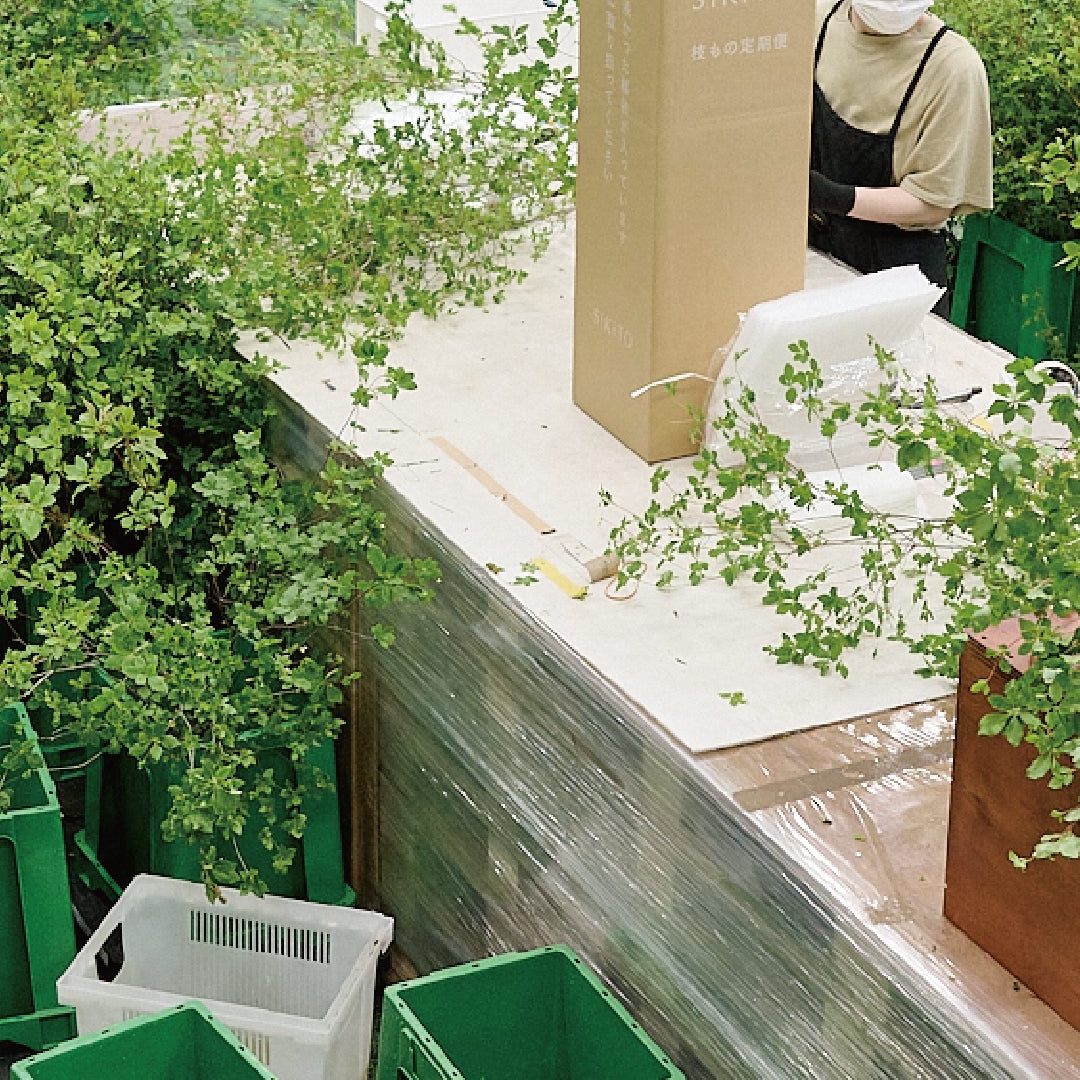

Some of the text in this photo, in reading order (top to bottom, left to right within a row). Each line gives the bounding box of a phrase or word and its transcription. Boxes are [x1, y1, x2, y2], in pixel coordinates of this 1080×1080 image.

[691, 32, 787, 60] 枝もの定期便
